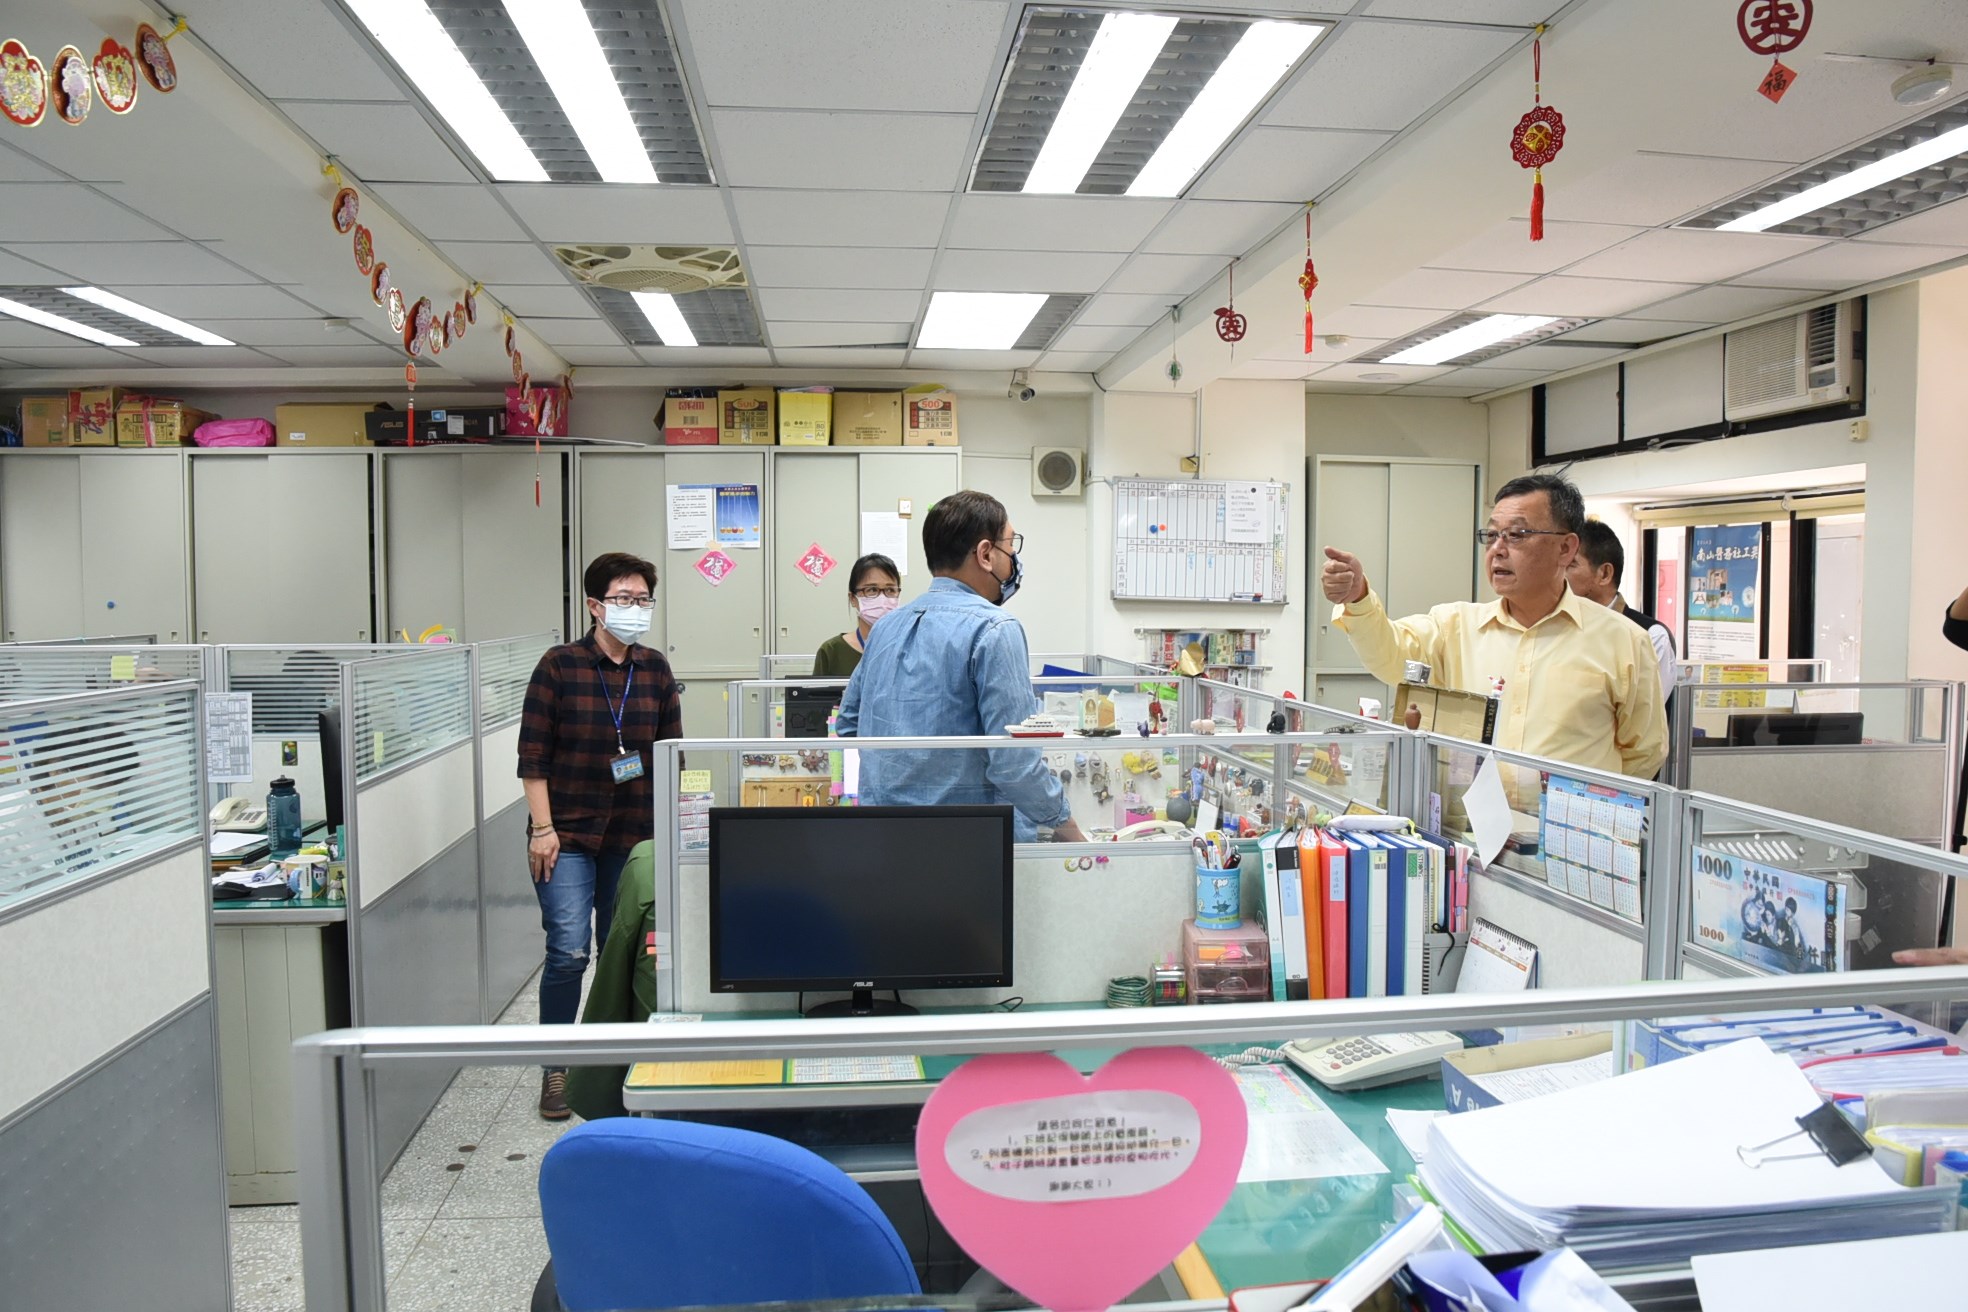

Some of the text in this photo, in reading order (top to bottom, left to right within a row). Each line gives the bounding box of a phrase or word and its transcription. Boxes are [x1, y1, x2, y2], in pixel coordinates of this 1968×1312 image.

[1764, 69, 1787, 95] 福
[1696, 854, 1732, 880] 1000
[1744, 867, 1780, 889] 中華民國
[1699, 924, 1725, 942] 1000
